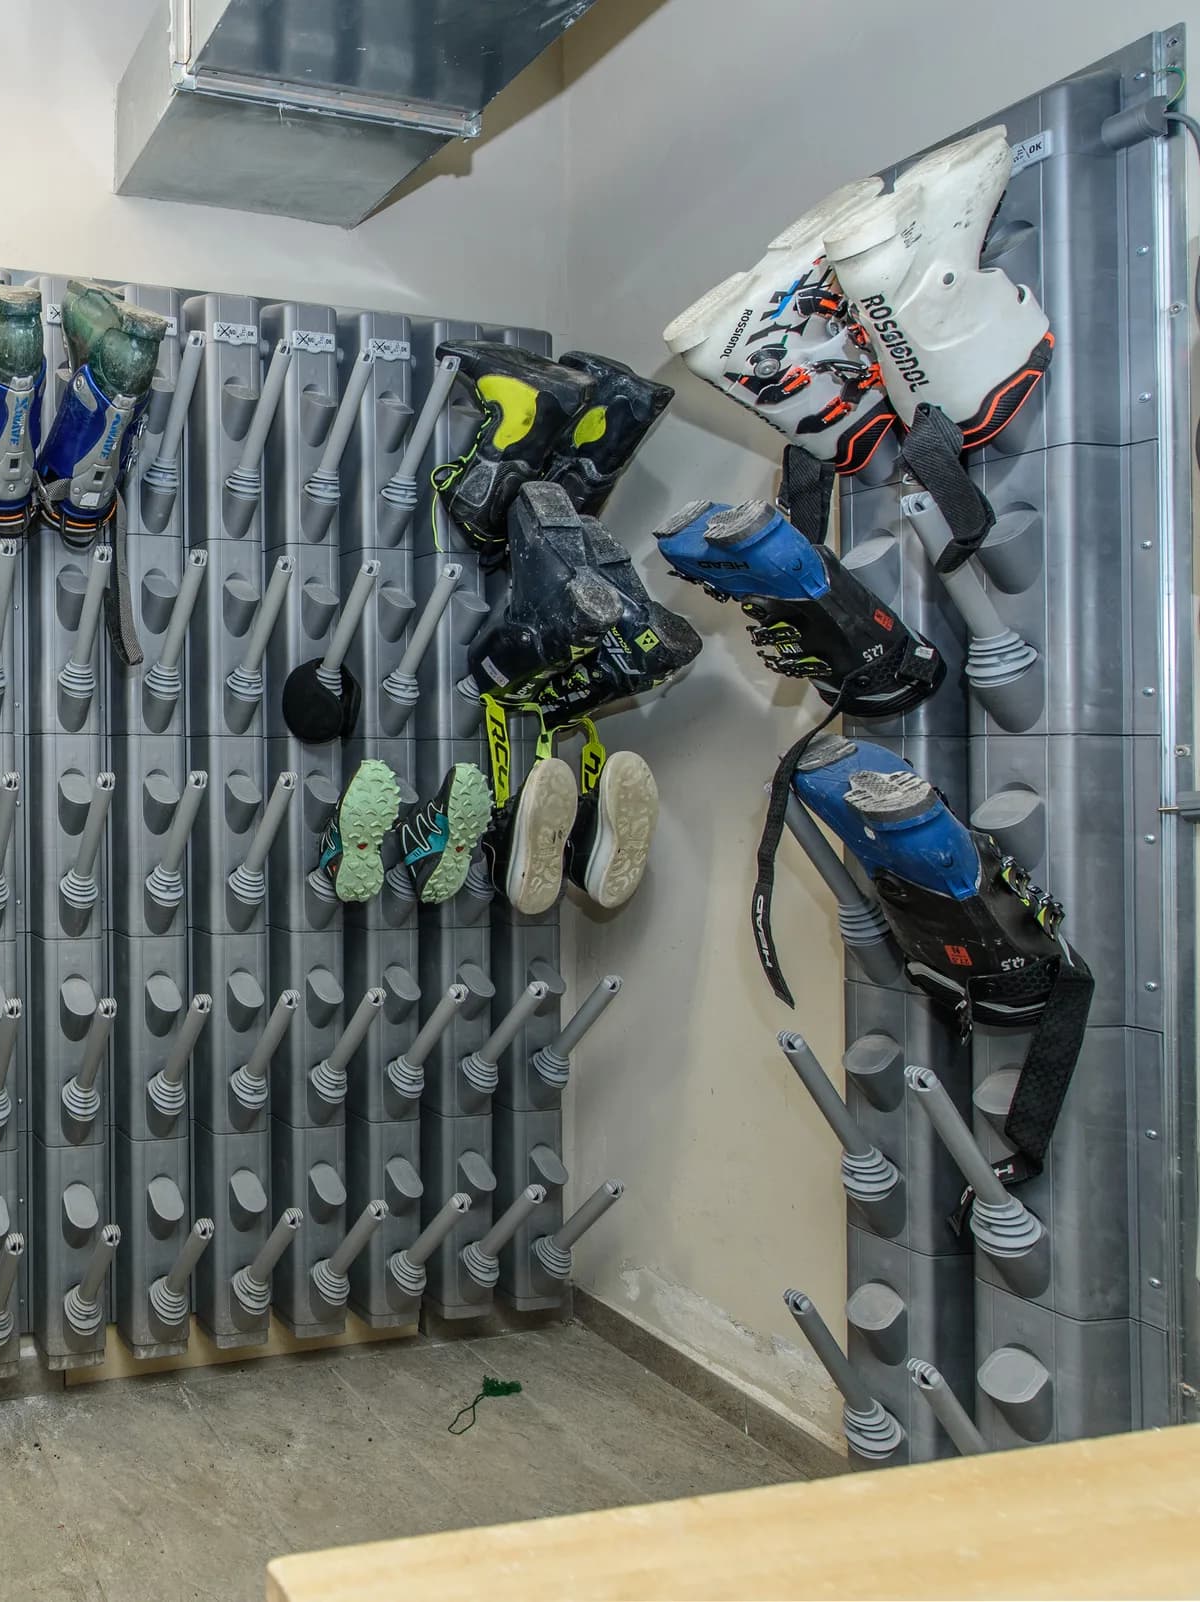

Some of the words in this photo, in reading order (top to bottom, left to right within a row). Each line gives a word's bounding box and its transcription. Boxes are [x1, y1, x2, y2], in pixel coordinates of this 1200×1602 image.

[1029, 142, 1042, 154] OK
[720, 308, 753, 360] ROSSIGNOL
[860, 293, 930, 392] ROSSIGNOL
[697, 560, 751, 569] HEAD
[756, 894, 774, 968] HEAD
